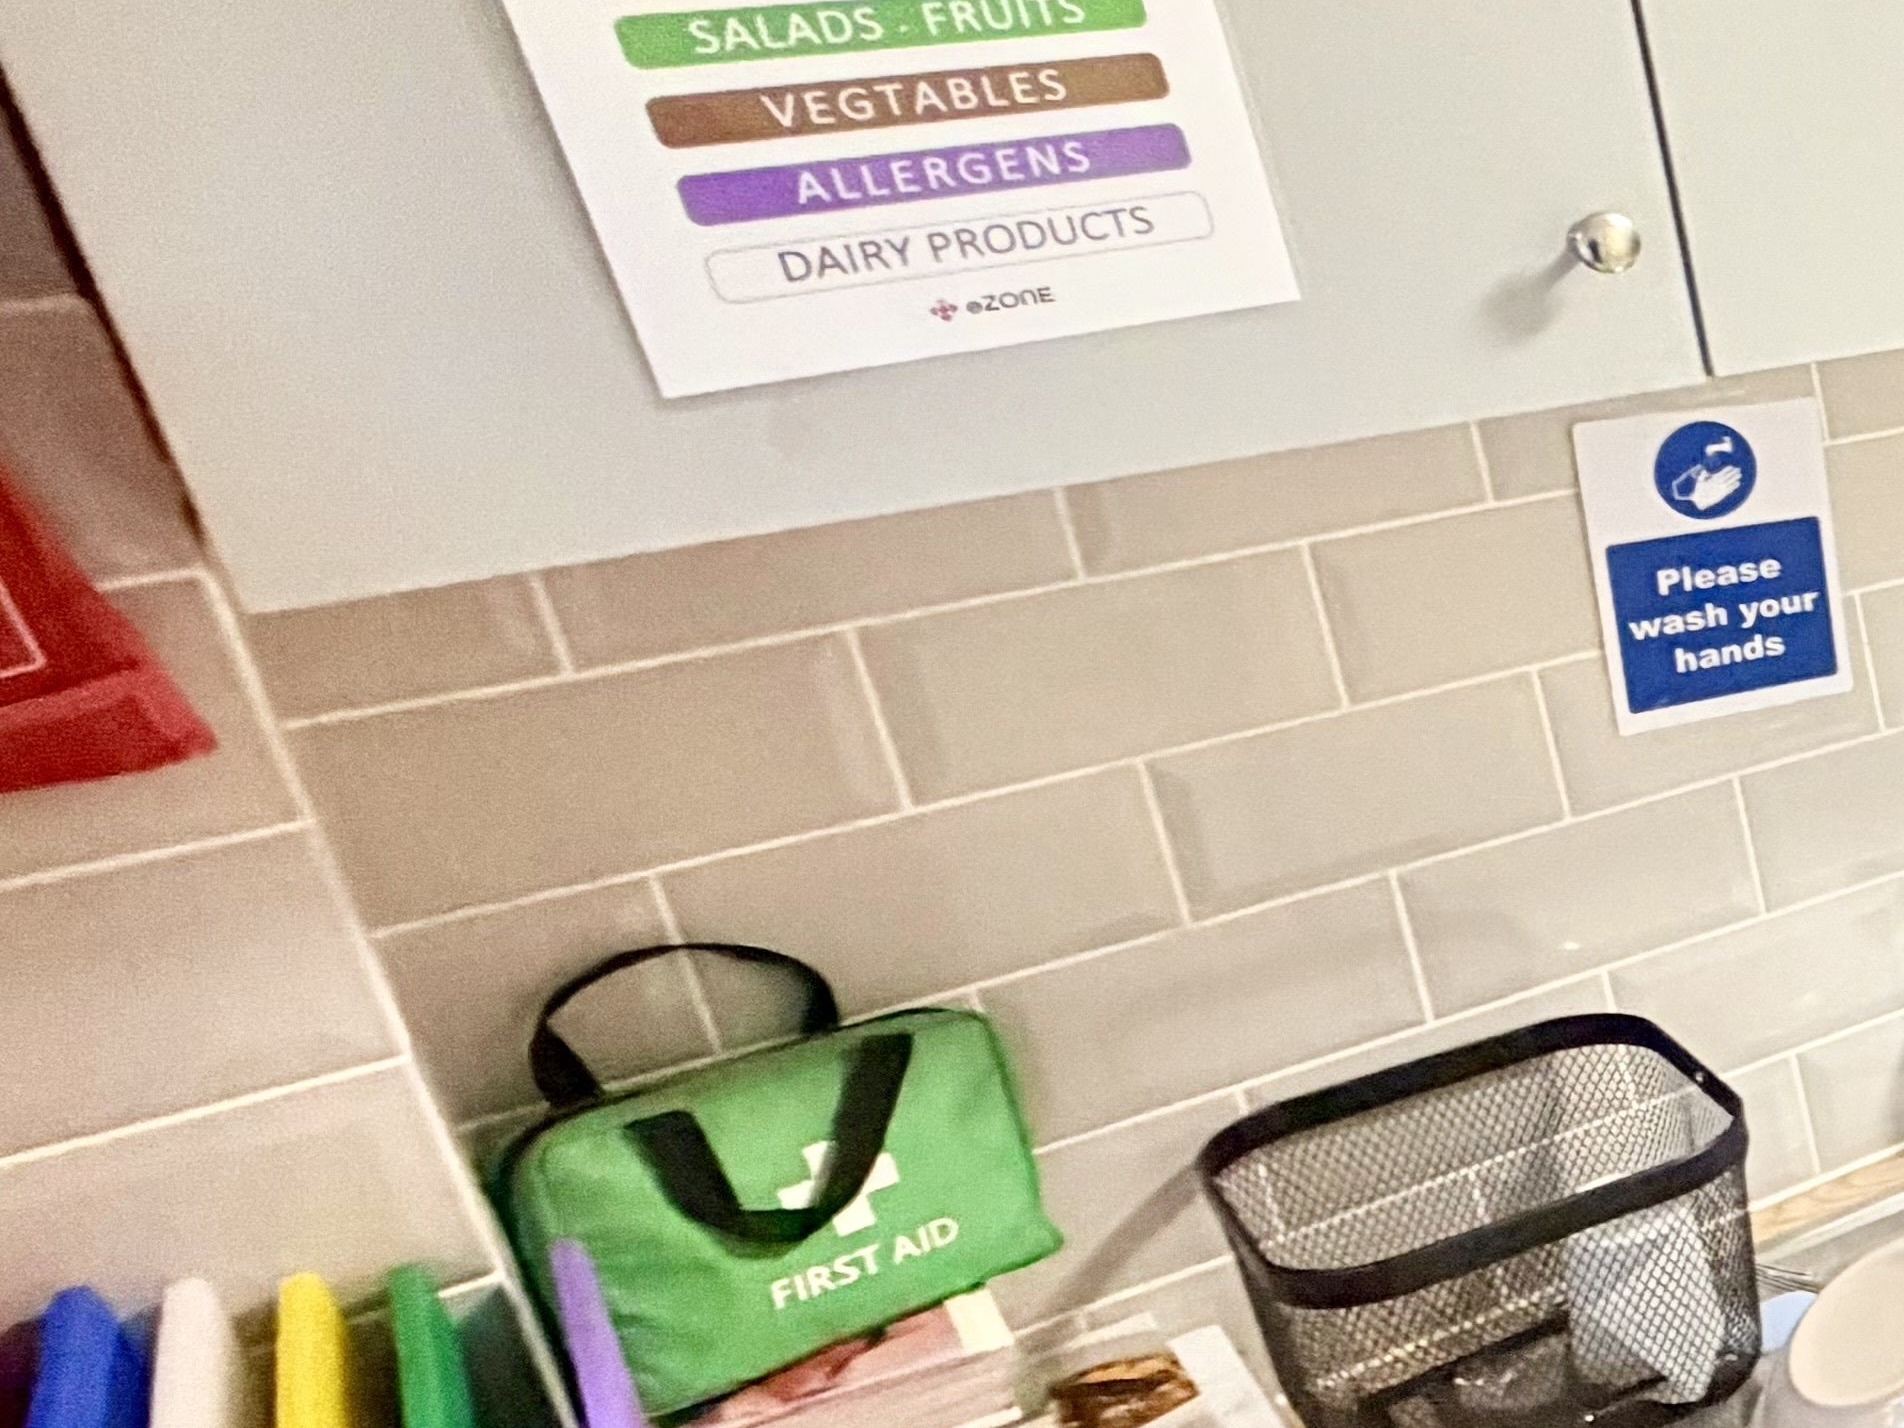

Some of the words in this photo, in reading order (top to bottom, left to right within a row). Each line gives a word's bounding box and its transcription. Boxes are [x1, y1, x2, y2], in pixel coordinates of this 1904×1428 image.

[687, 7, 883, 55] SALADS
[760, 69, 1068, 129] VEGTABLES
[797, 140, 1091, 207] ALLERGENS
[776, 235, 910, 284] DAIRY
[927, 205, 1156, 263] PRODUCTS
[1656, 557, 1783, 597] Please
[1628, 602, 1729, 642] wash
[1738, 591, 1822, 629] your
[1673, 633, 1788, 674] hands
[770, 1242, 880, 1311] FIRST
[893, 1216, 960, 1266] AID
